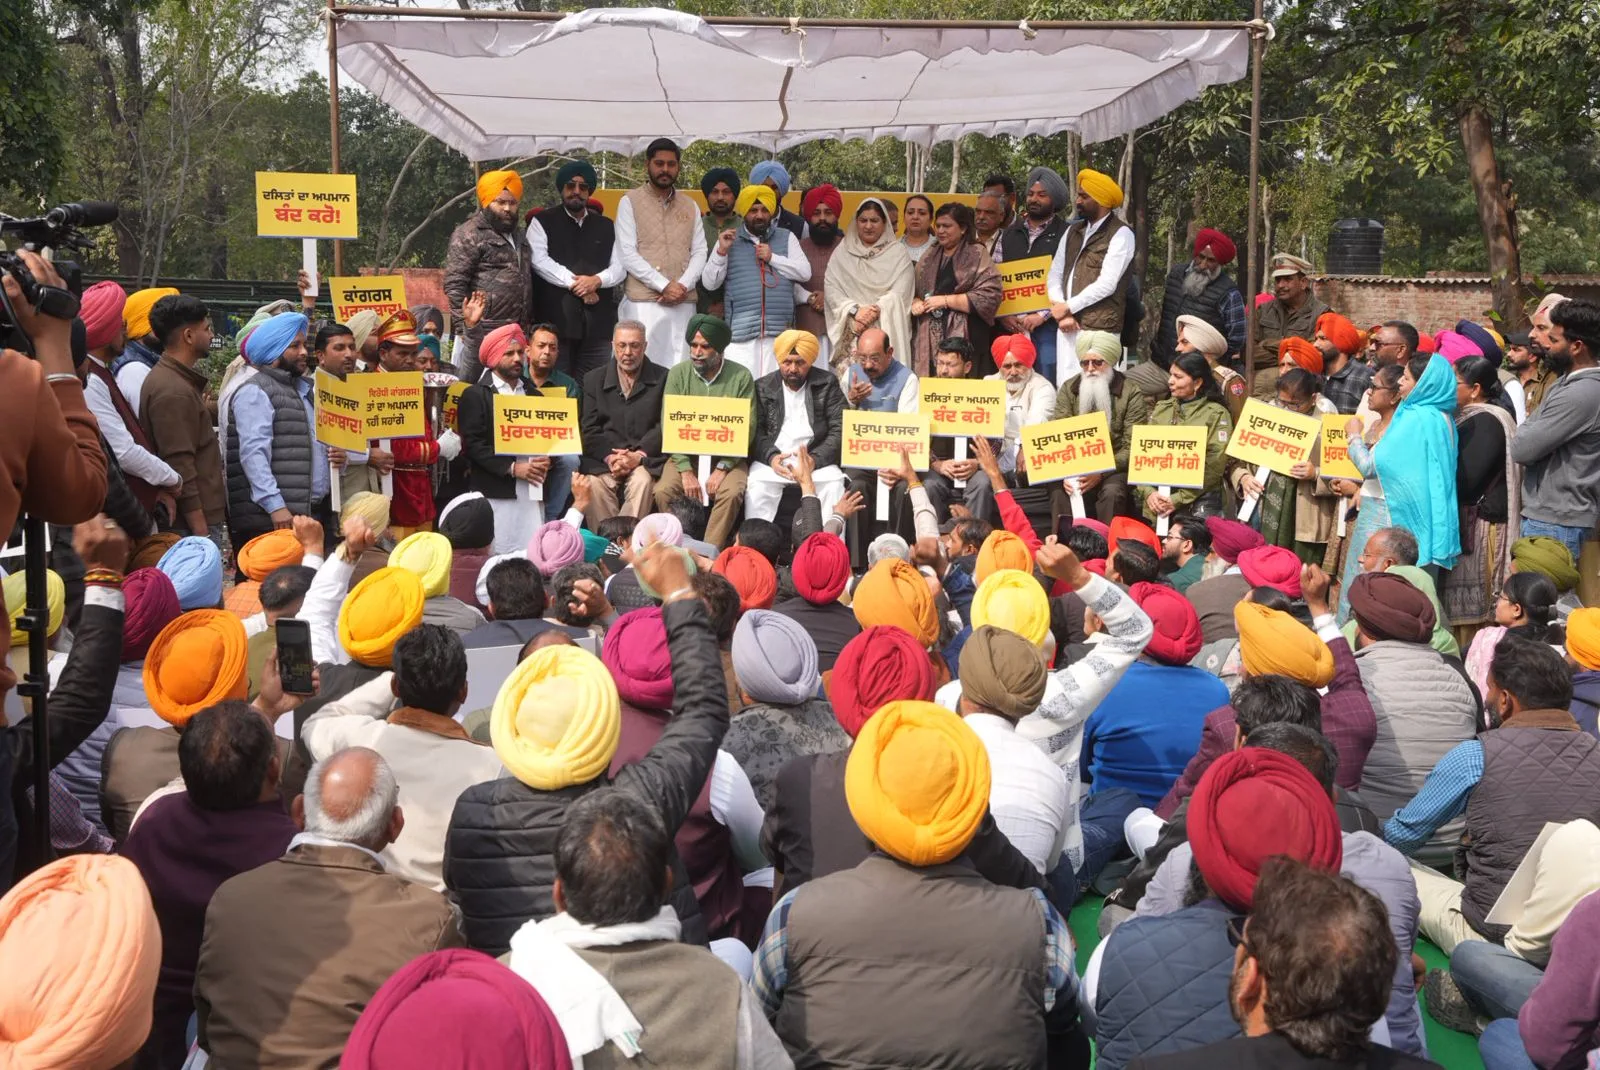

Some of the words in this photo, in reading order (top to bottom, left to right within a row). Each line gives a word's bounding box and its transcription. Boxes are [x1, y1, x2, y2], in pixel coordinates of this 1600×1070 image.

[262, 188, 294, 200] ਦਲਿਤਾਂ
[297, 192, 309, 201] ਦਾ
[311, 193, 350, 203] ਅਪਮਾਨ
[274, 203, 302, 223] ਬੰਦ
[307, 203, 341, 224] ਕਰੋ!
[1014, 269, 1044, 281] ਬਾਜਵਾ
[342, 285, 392, 303] ਕਾਂਗਰਸ
[335, 395, 359, 411] ਬਾਜਵਾ
[376, 402, 386, 411] ਦਾ
[387, 400, 419, 410] ਅਪਮਾਨ
[924, 392, 951, 403] ਦਲਿਤਾਂ
[966, 396, 1000, 405] ਅਪਮਾਨ
[503, 408, 532, 423] ਪ੍ਰਤਾਪ
[535, 410, 568, 421] ਬਾਜਵਾ
[669, 411, 696, 422] ਦਲਿਤਾਂ
[698, 414, 708, 422] ਦਾ
[711, 415, 744, 424] ਅਪਮਾਨ
[932, 405, 957, 422] ਬੰਦ
[961, 406, 990, 424] ਕਰੋ!
[500, 425, 574, 442] ਮੁਰਦਾਬਾਦ!
[678, 424, 701, 441] ਬੰਦ
[705, 425, 734, 443] ਕਰੋ!
[852, 423, 882, 437] ਪ੍ਰਤਾਪ
[885, 425, 920, 436] ਬਾਜਵਾ
[1249, 414, 1276, 431] ਪ੍ਰਤਾਪ
[1278, 424, 1308, 441] ਬਾਜਵਾ
[1032, 433, 1061, 450] ਪ੍ਰਤਾਪ
[1063, 427, 1098, 440] ਬਾਜਵਾ
[1326, 429, 1343, 443] ਪ੍ਰਤਾਪ
[1080, 438, 1106, 457] ਮੰਗੇ
[1139, 439, 1164, 453] ਪ੍ਰਤਾਪ
[1167, 440, 1197, 450] ਬਾਜਵਾ
[1238, 428, 1306, 461] ਮੁਰਦਾਬਾਦ!
[1177, 453, 1200, 470] ਮੰਗੇ
